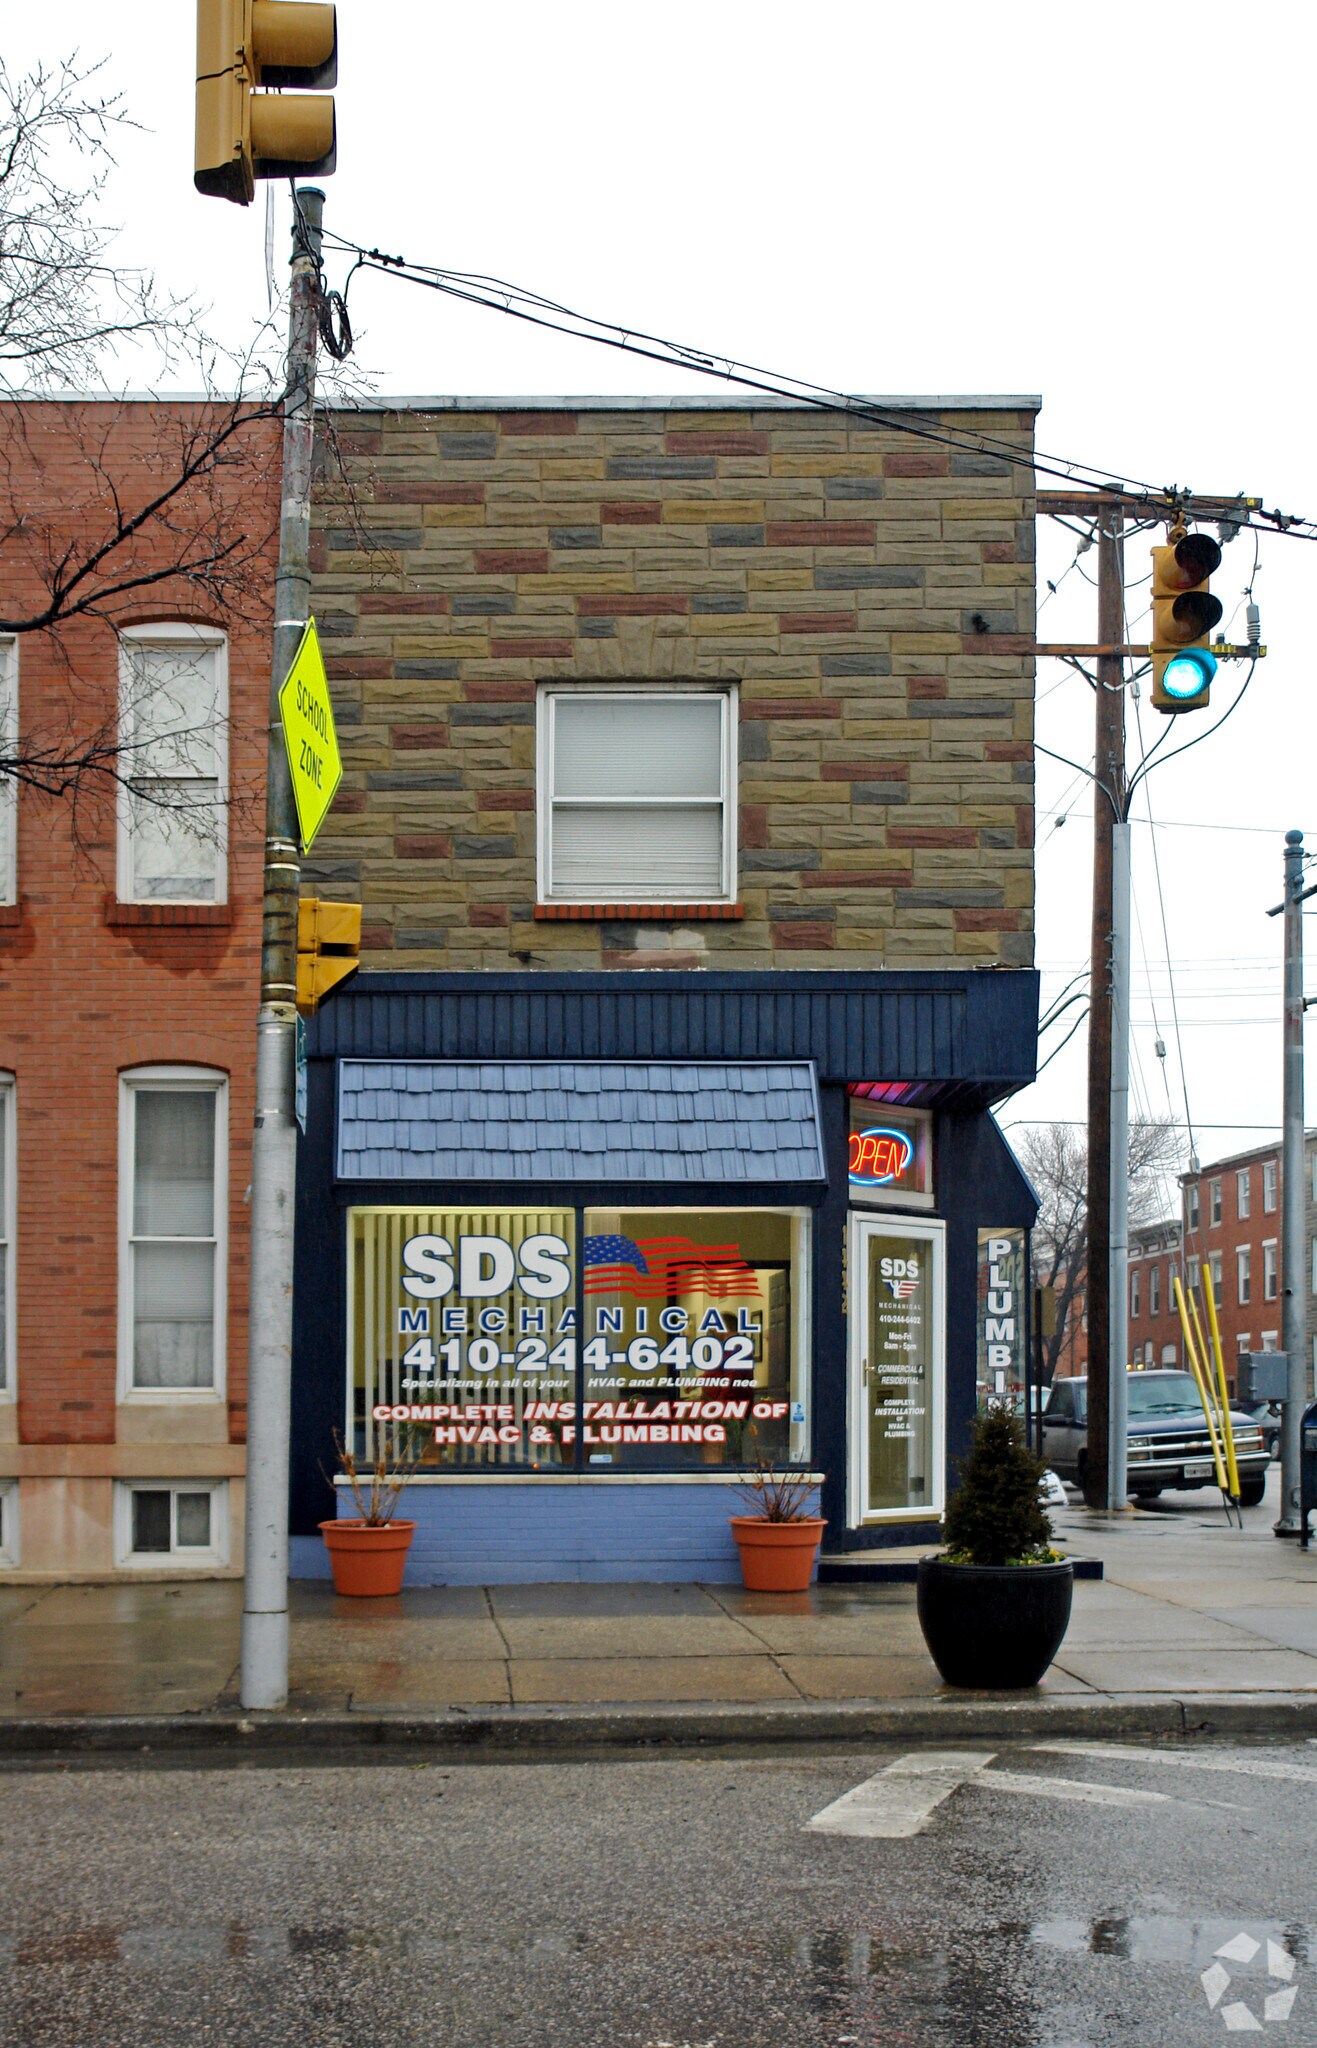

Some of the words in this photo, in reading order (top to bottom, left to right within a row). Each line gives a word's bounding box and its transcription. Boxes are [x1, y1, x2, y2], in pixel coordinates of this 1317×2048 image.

[297, 679, 328, 745] SCHOOL
[300, 738, 323, 790] ZONE
[402, 1233, 572, 1300] SDS
[880, 1257, 919, 1278] SDS
[878, 1302, 921, 1310] MECHANICAL
[398, 1306, 762, 1333] MECHANICAL
[879, 1314, 921, 1325] 410-244-6402
[888, 1331, 912, 1340] Mon-Fri
[884, 1341, 899, 1350] 8am
[903, 1342, 917, 1351] 5pm
[402, 1336, 755, 1373] 410-244-6402
[877, 1364, 918, 1374] COMMERCIAL
[918, 1365, 923, 1374] &
[401, 1378, 482, 1390] Specializing
[485, 1378, 499, 1388] in
[502, 1378, 520, 1388] all
[522, 1378, 537, 1388] of
[538, 1379, 570, 1390] your
[588, 1378, 626, 1388] HVAC
[629, 1377, 655, 1387] and
[657, 1377, 730, 1388] PLUMBING
[881, 1376, 919, 1385] RESIDENTIAL
[372, 1404, 514, 1421] COMPLETE
[522, 1400, 750, 1421] INSTALLATION
[752, 1401, 789, 1419] OF
[874, 1407, 925, 1416] INSTALLATION
[434, 1425, 521, 1444] HVAC
[528, 1425, 555, 1444] &
[561, 1424, 727, 1443] PLUMBING
